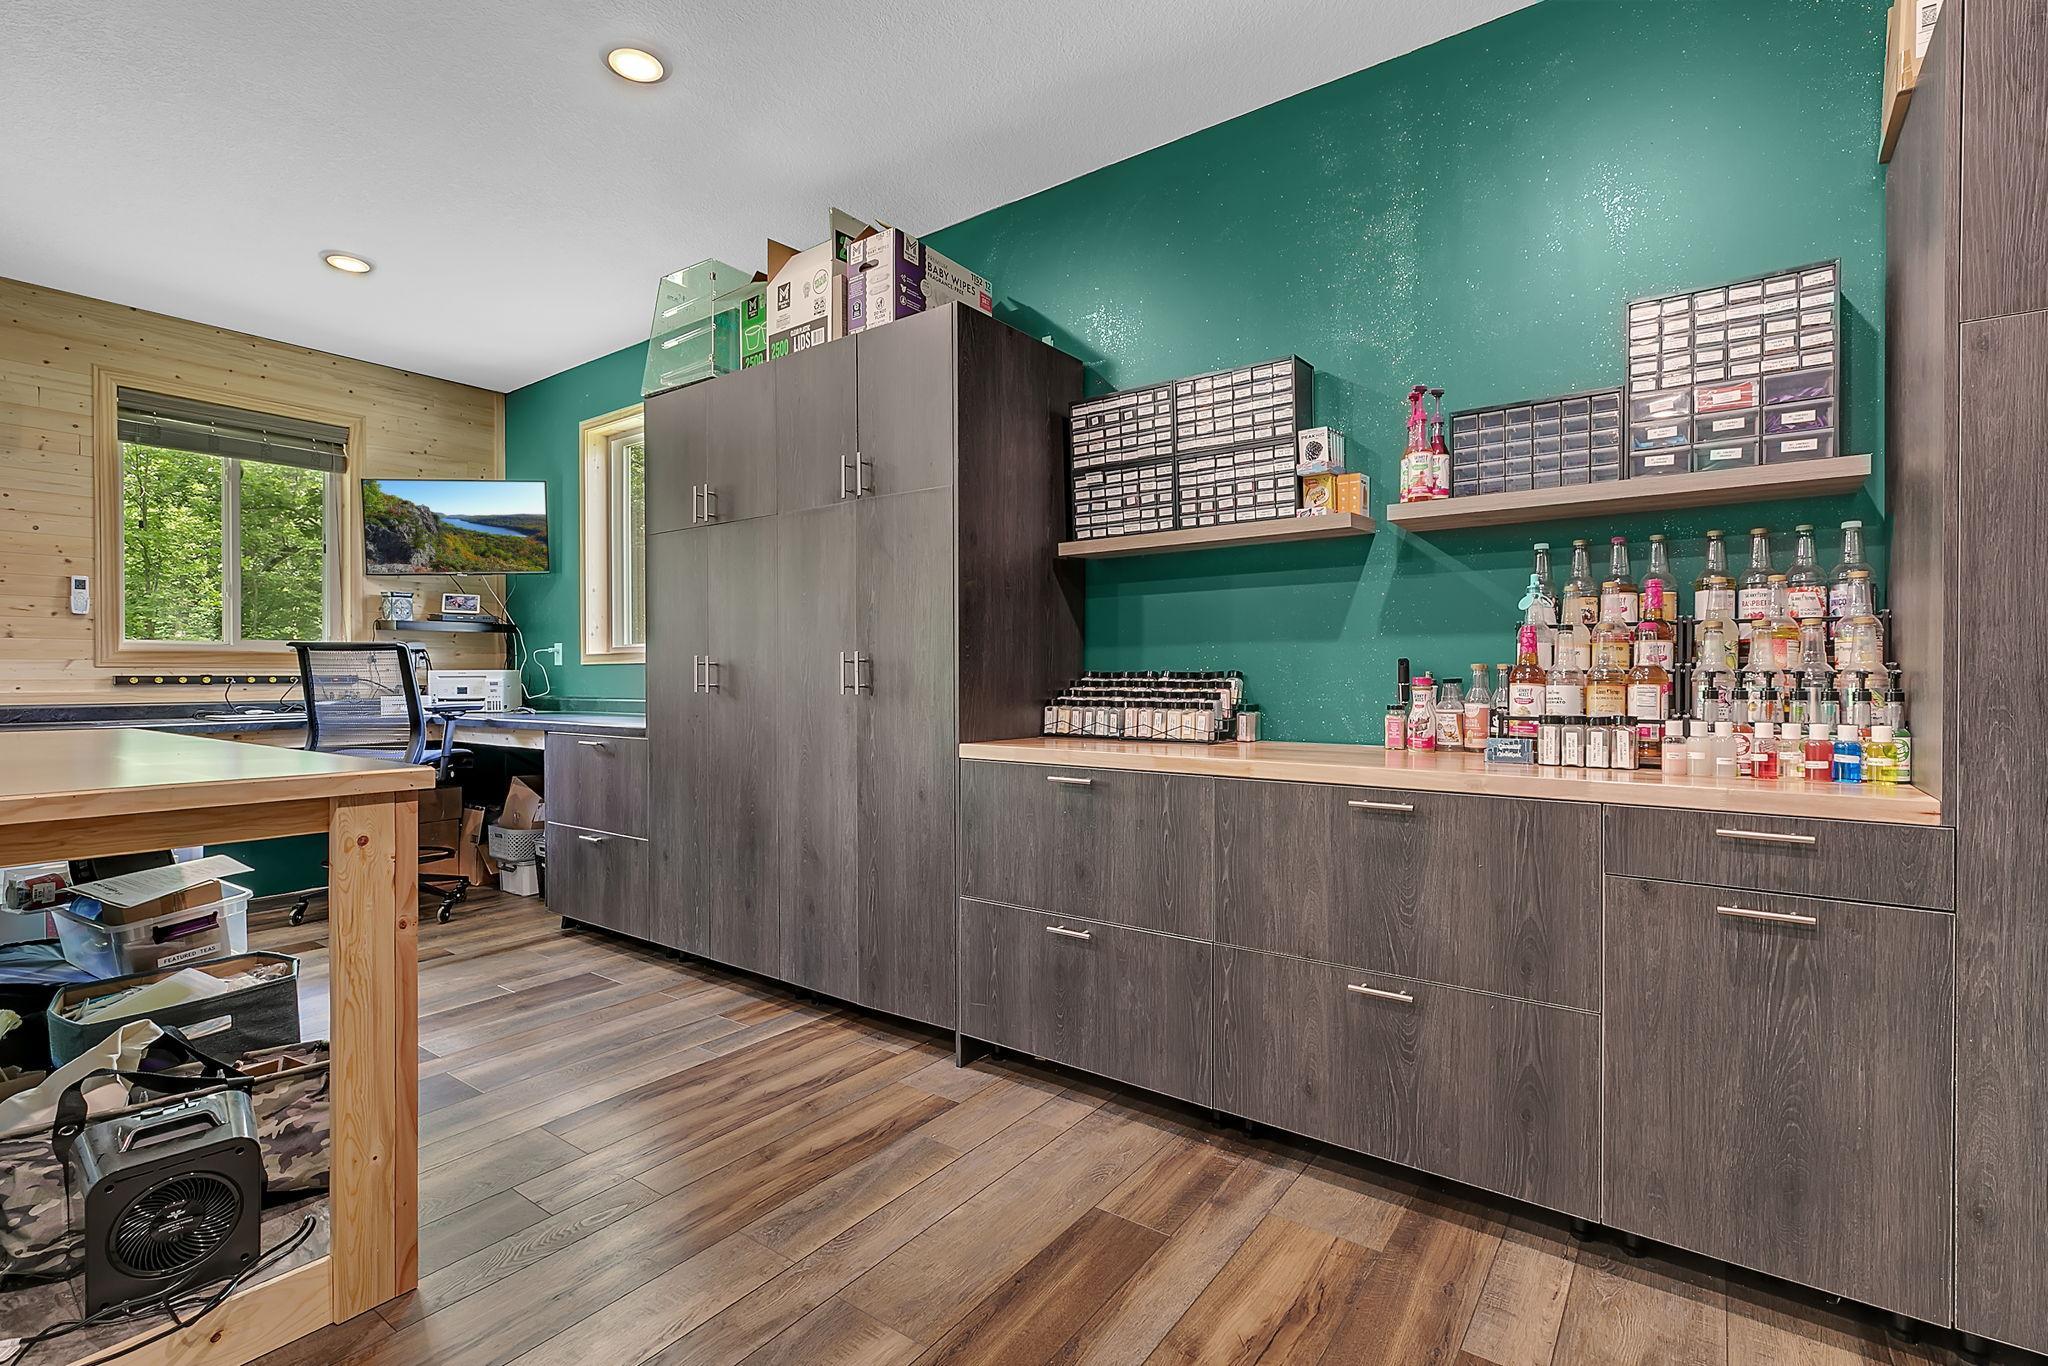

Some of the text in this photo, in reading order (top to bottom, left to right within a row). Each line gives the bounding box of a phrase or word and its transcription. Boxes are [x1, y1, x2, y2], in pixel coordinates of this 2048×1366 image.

[927, 261, 976, 296] BABY WIPES
[771, 338, 789, 360] 2500
[793, 331, 811, 353] LIDS
[163, 945, 216, 964] FEATURED TEAS
